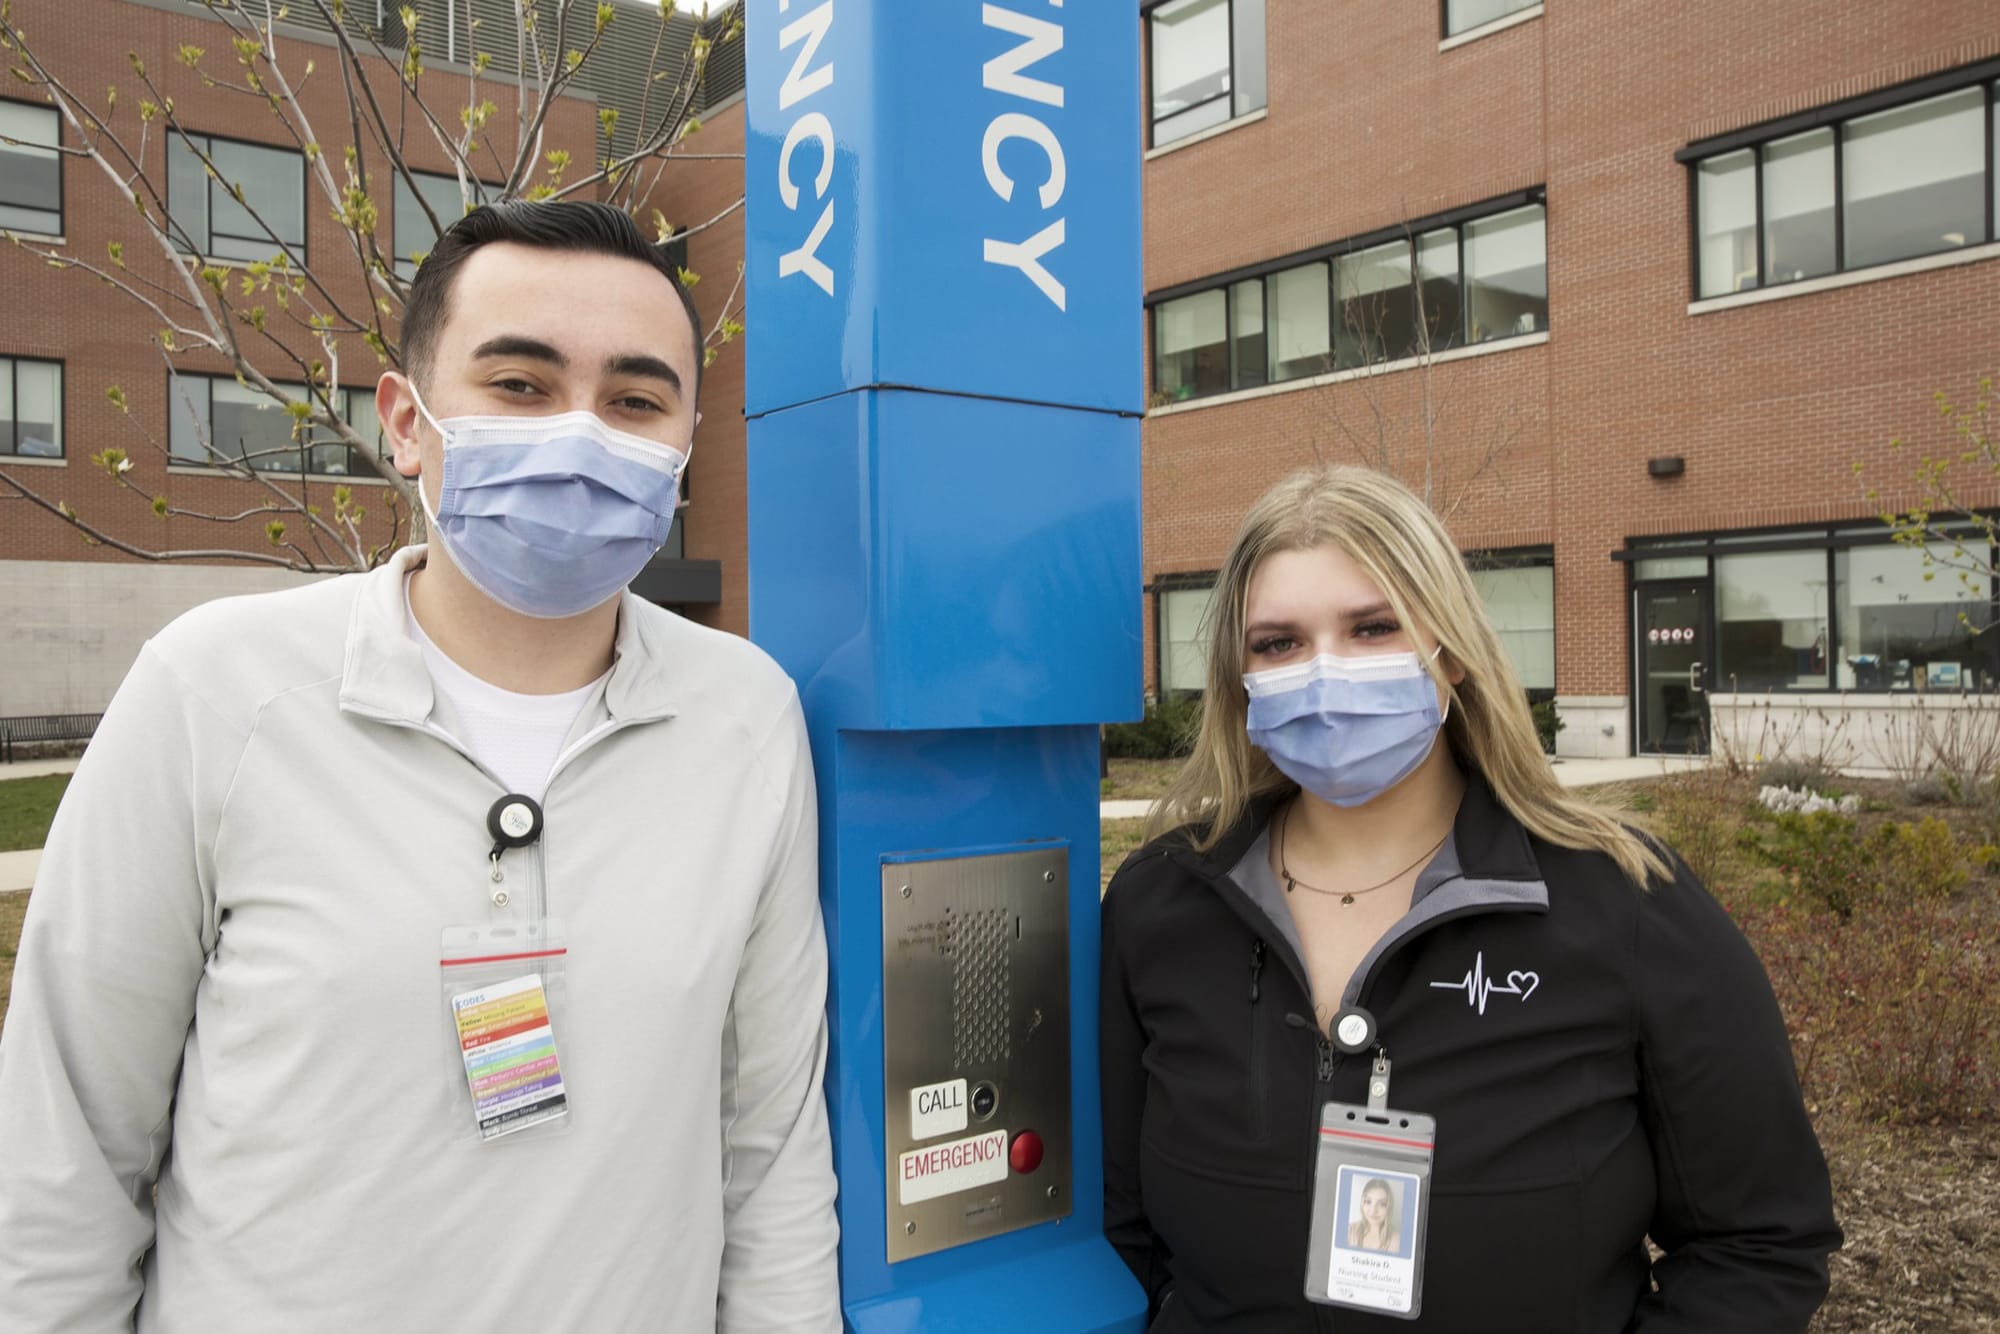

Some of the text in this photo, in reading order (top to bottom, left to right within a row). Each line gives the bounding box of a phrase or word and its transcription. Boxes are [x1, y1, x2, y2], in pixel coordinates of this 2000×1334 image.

[779, 0, 834, 297] NCY
[982, 0, 1066, 312] NCY
[457, 994, 485, 1008] CODES
[918, 1085, 963, 1115] CALL
[904, 1135, 1005, 1180] EMERGENCY
[1338, 1267, 1401, 1285] Nursing Student
[1351, 1256, 1381, 1268] Shakira
